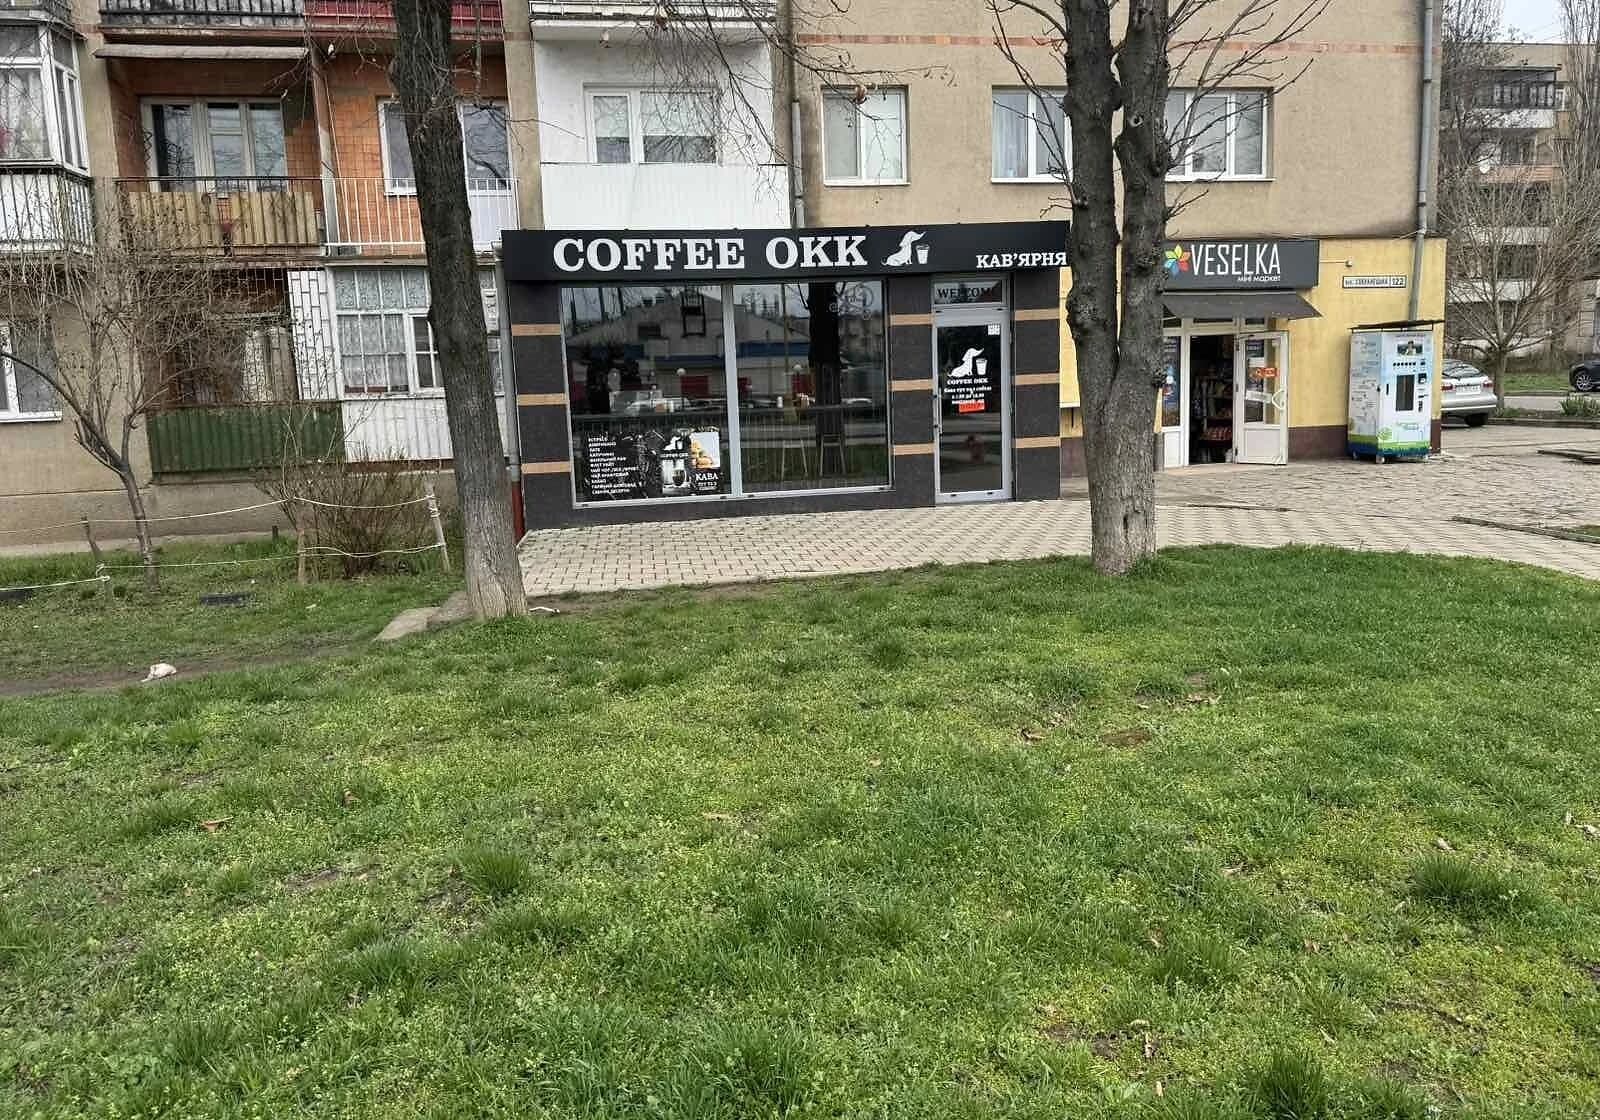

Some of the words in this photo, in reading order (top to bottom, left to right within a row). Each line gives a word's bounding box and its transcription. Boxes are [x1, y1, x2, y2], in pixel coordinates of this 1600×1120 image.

[553, 238, 745, 272] COFFEE
[765, 235, 868, 269] OKK
[1190, 243, 1281, 276] VESELKA
[1392, 277, 1404, 286] 122
[695, 472, 719, 481] КАВА
